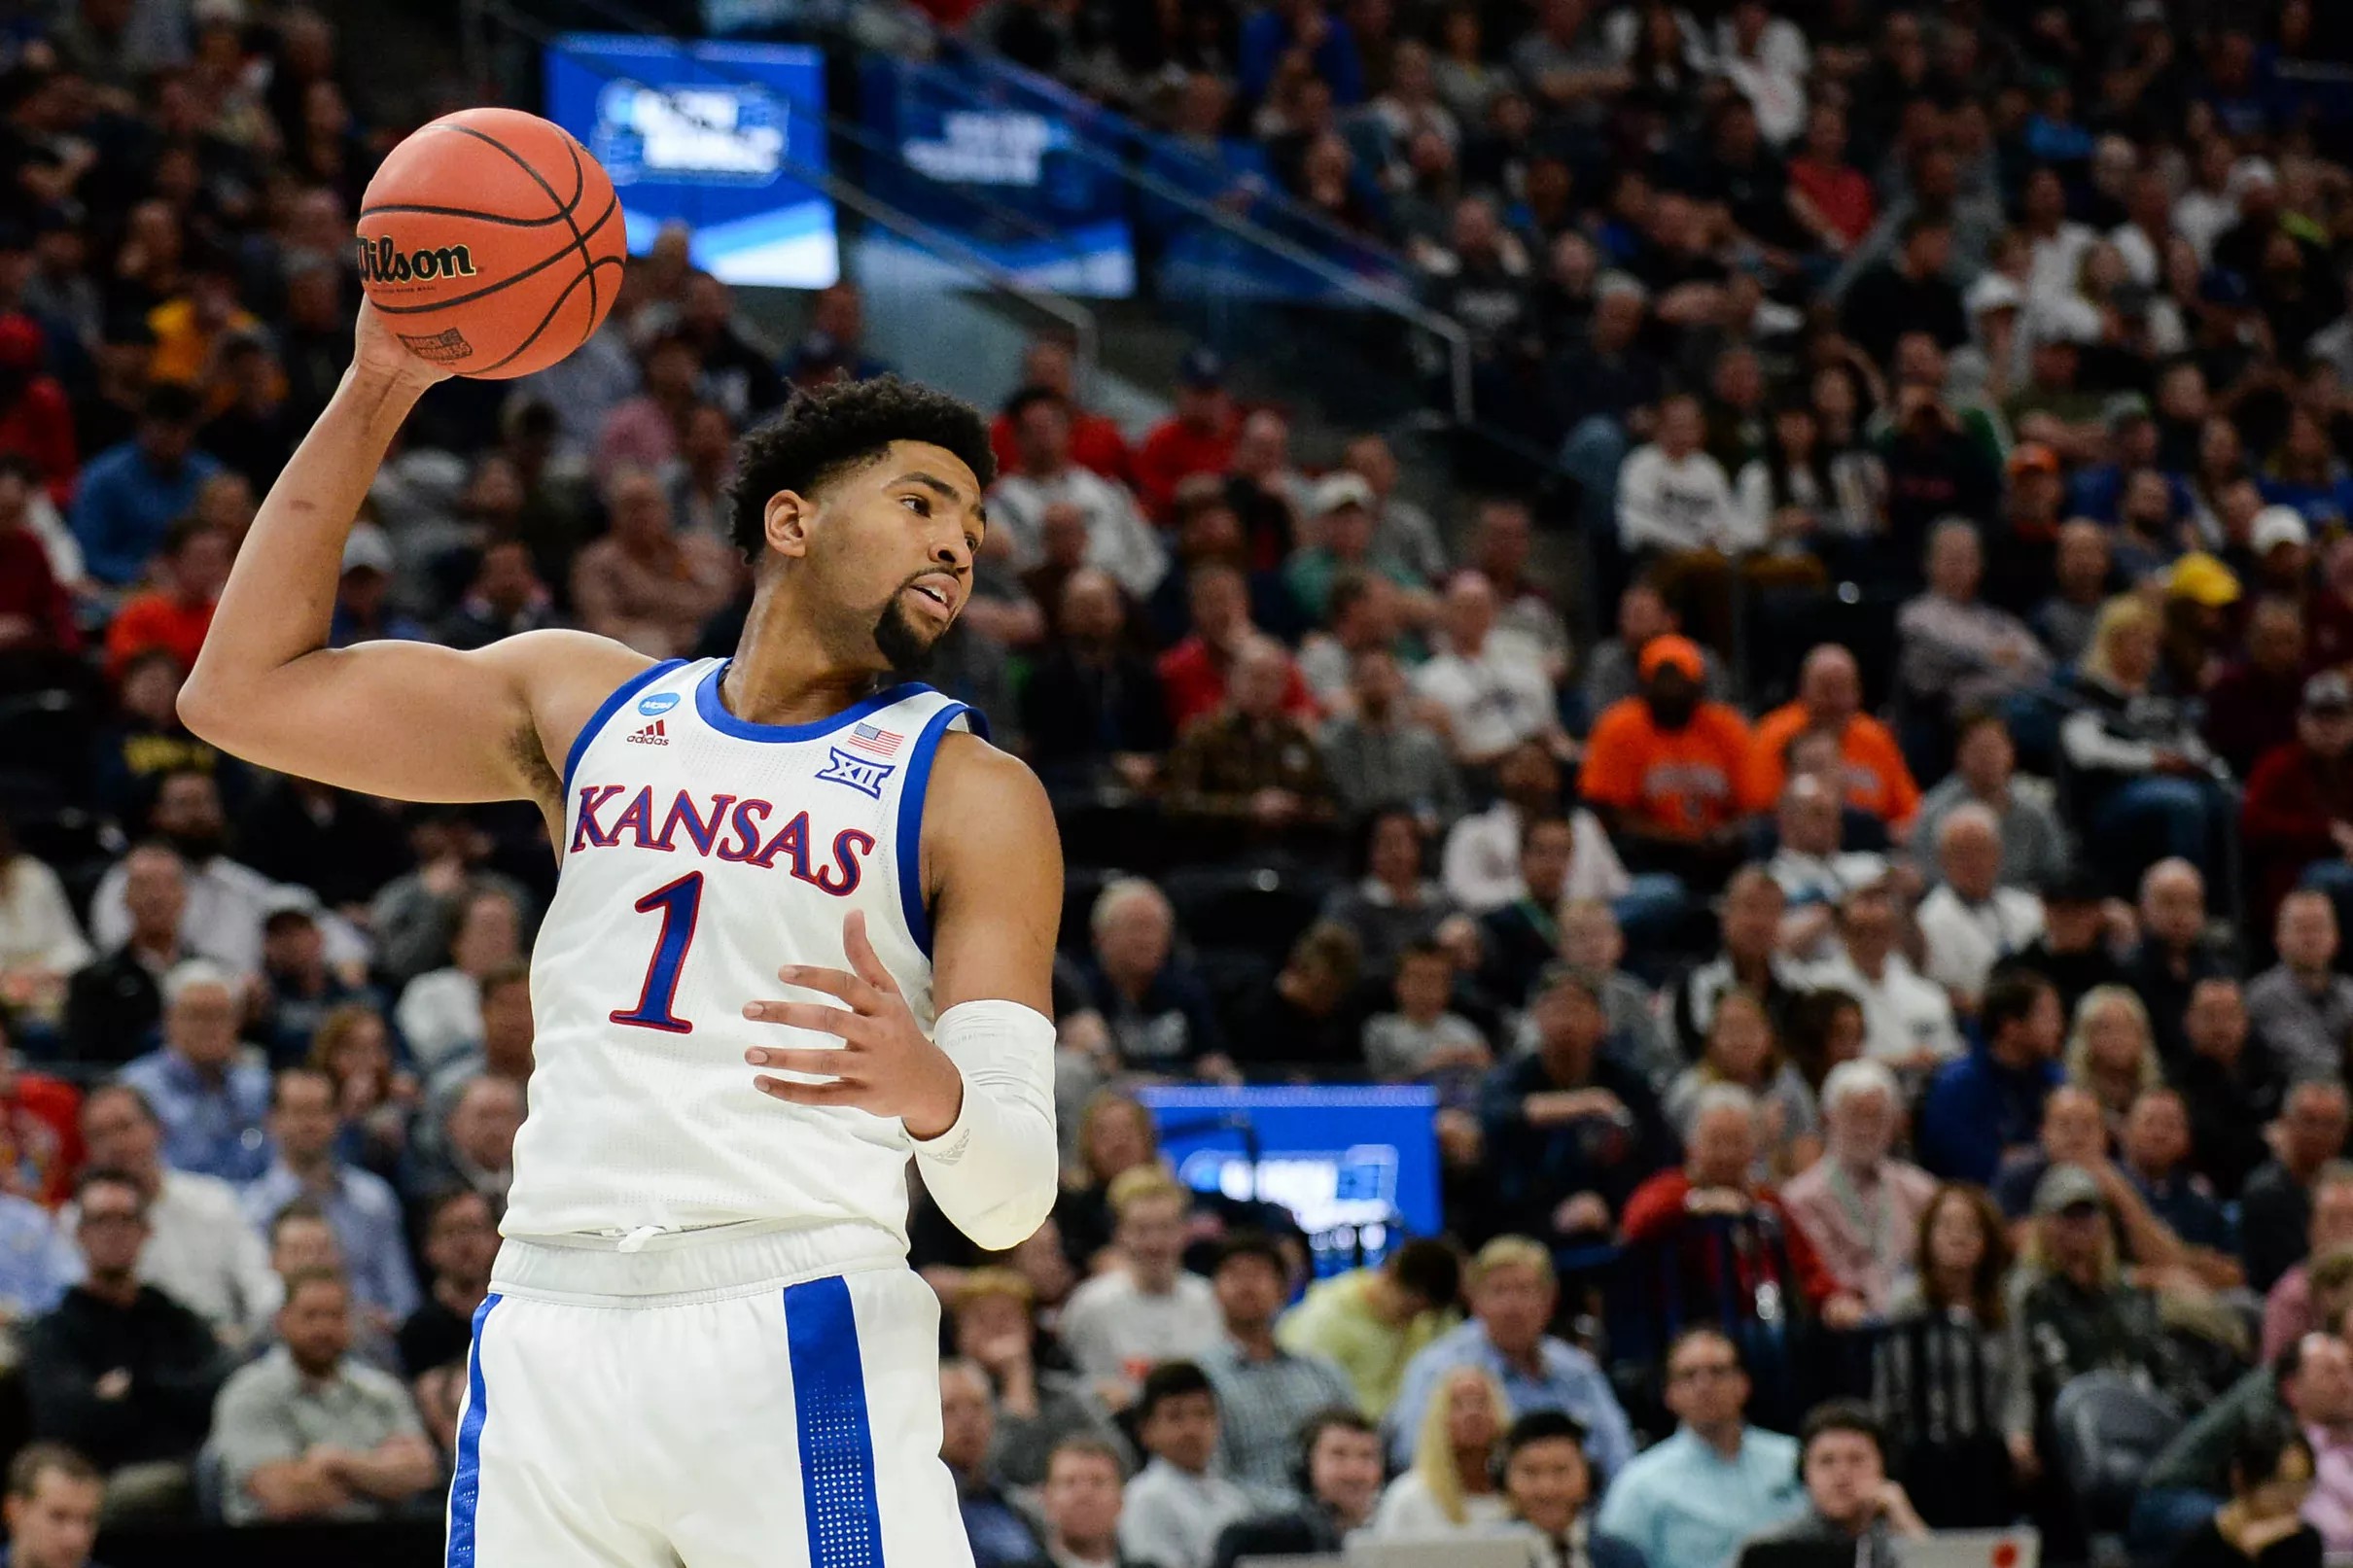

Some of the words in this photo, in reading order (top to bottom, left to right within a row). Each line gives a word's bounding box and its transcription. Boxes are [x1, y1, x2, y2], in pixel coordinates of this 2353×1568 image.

[626, 734, 669, 746] adidas
[570, 784, 876, 896] KANSAS
[609, 870, 704, 1033] 1
